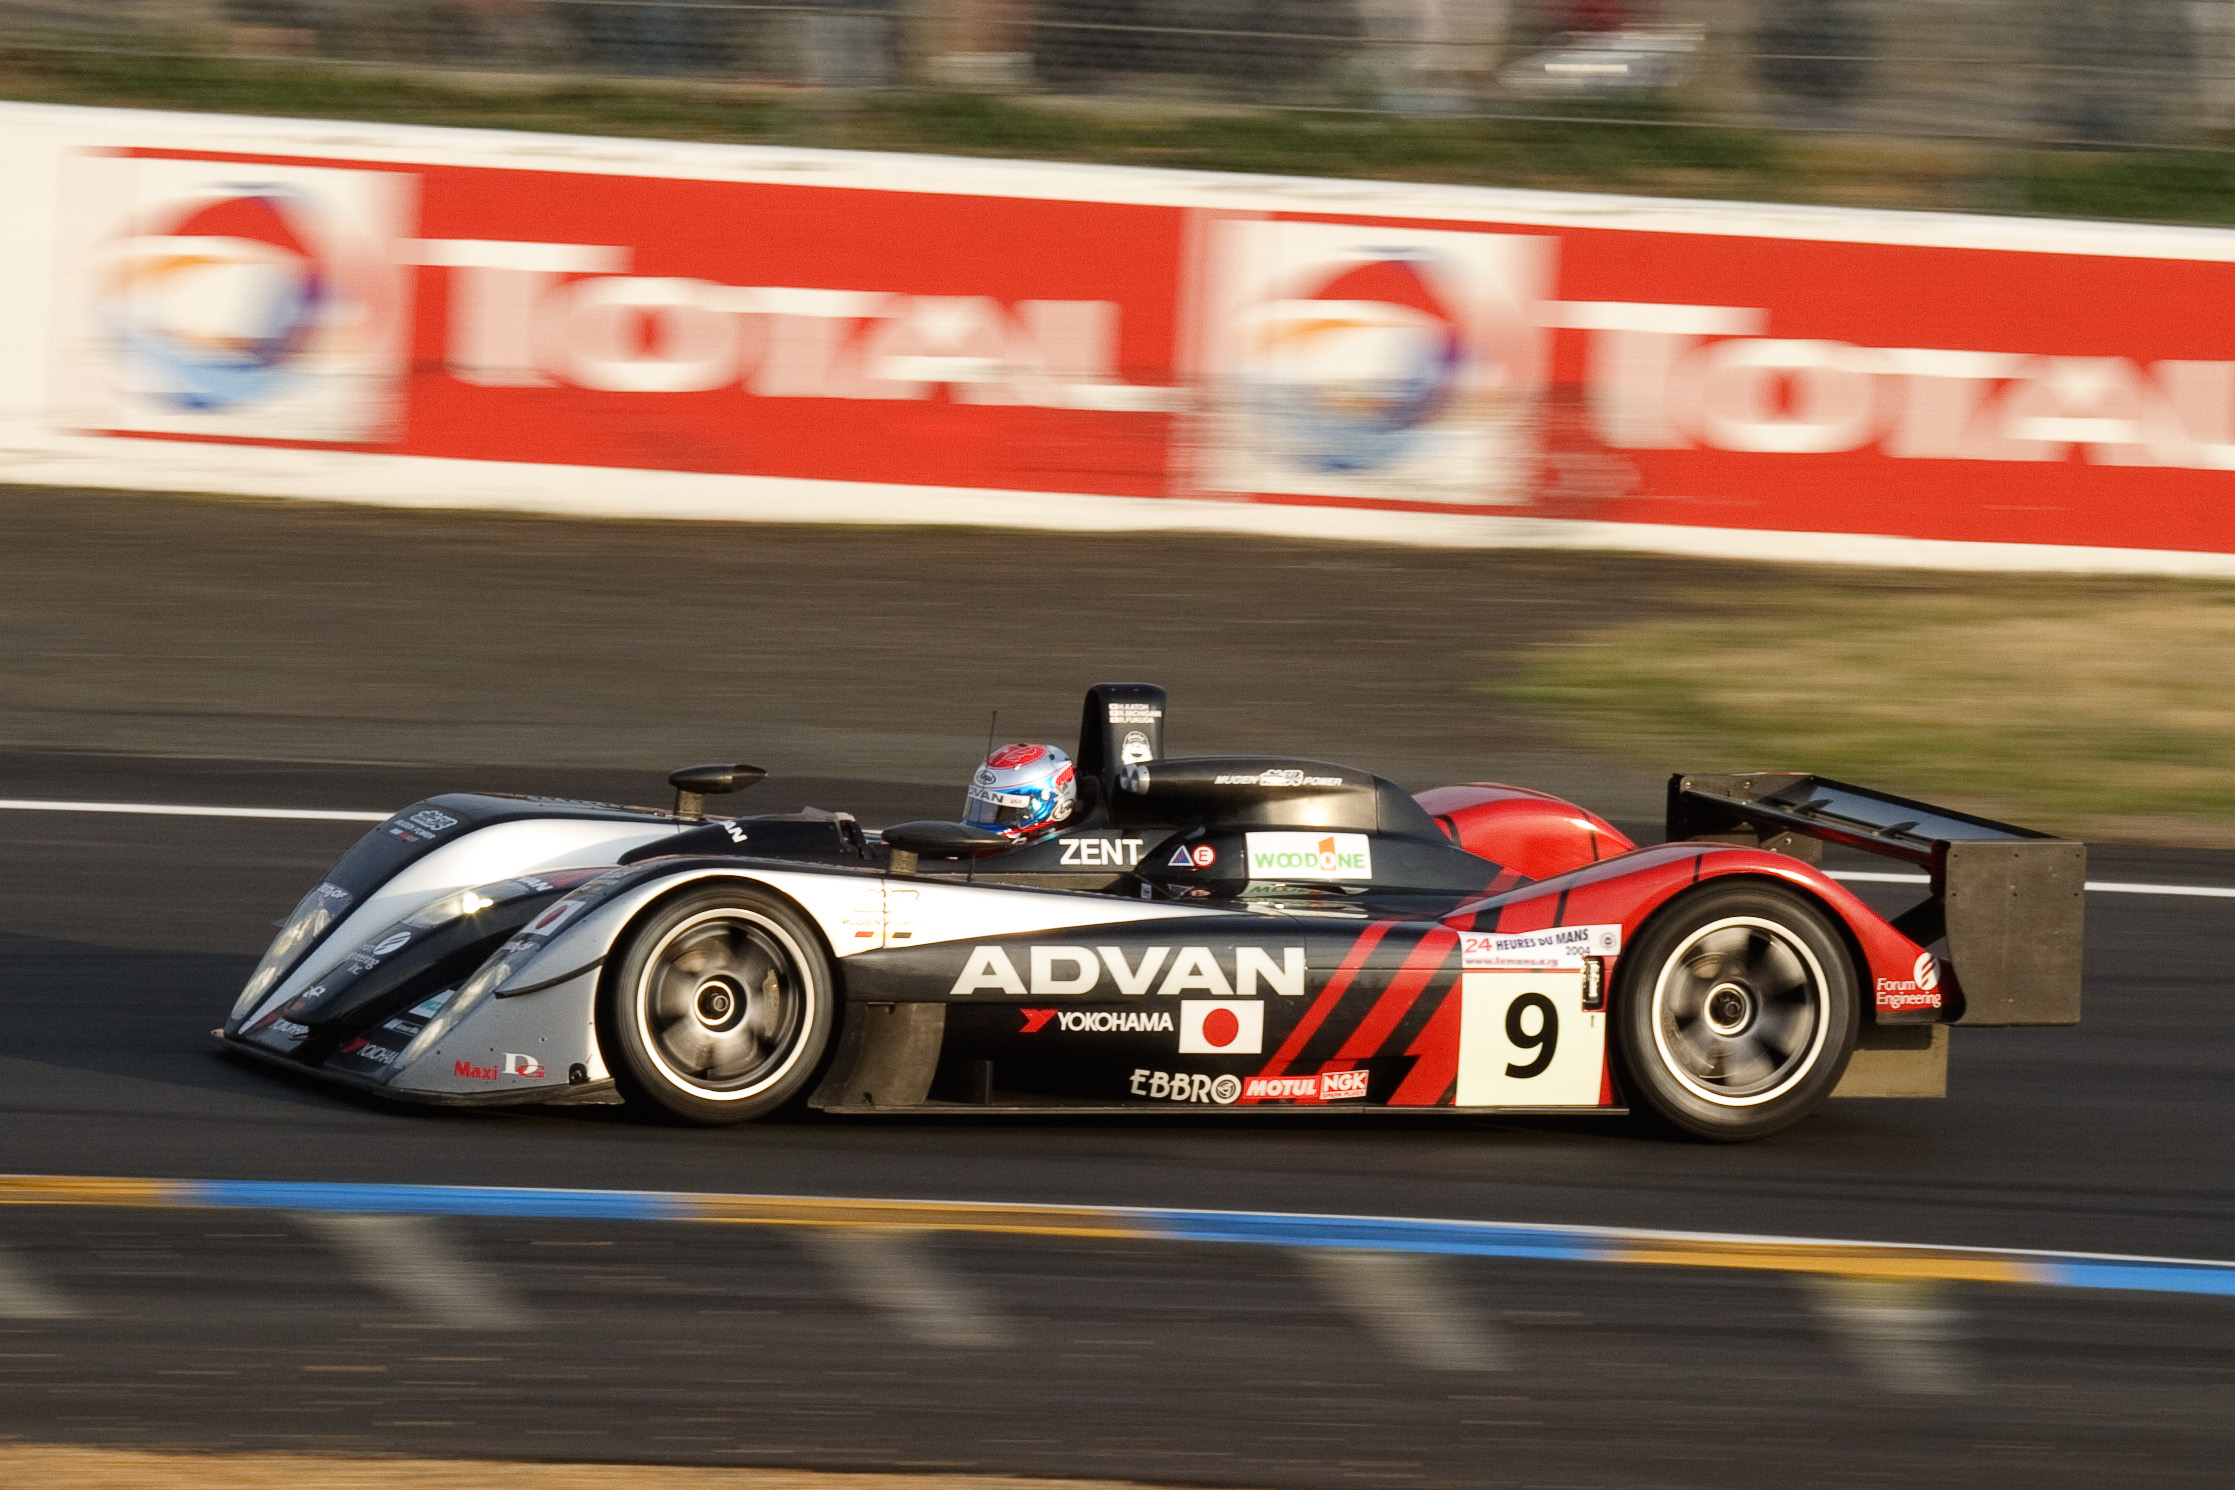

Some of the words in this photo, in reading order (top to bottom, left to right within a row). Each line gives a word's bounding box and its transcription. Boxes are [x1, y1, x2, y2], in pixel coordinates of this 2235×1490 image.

[398, 238, 1174, 413] TOTAL
[1214, 775, 1259, 785] MUGEN
[1302, 777, 1343, 787] POWER
[1058, 838, 1144, 866] ZENT
[1254, 850, 1366, 870] WOODONE
[1464, 937, 1493, 953] 24
[1495, 938, 1536, 951] HEURES
[1540, 937, 1553, 946] DU
[1556, 928, 1589, 944] MANS
[1565, 946, 1591, 956] 2004
[950, 945, 1306, 996] ADVAN
[1464, 956, 1559, 967] www.lemans.org
[1876, 977, 1916, 991] Forum
[1876, 991, 1942, 1009] Engineering
[1057, 1011, 1174, 1032] YOKOHAMA
[1504, 991, 1559, 1080] 9
[454, 1059, 499, 1081] Maxi
[1129, 1068, 1242, 1105] EBBRO
[1245, 1079, 1318, 1097] MOTUL
[1323, 1072, 1367, 1092] NGK
